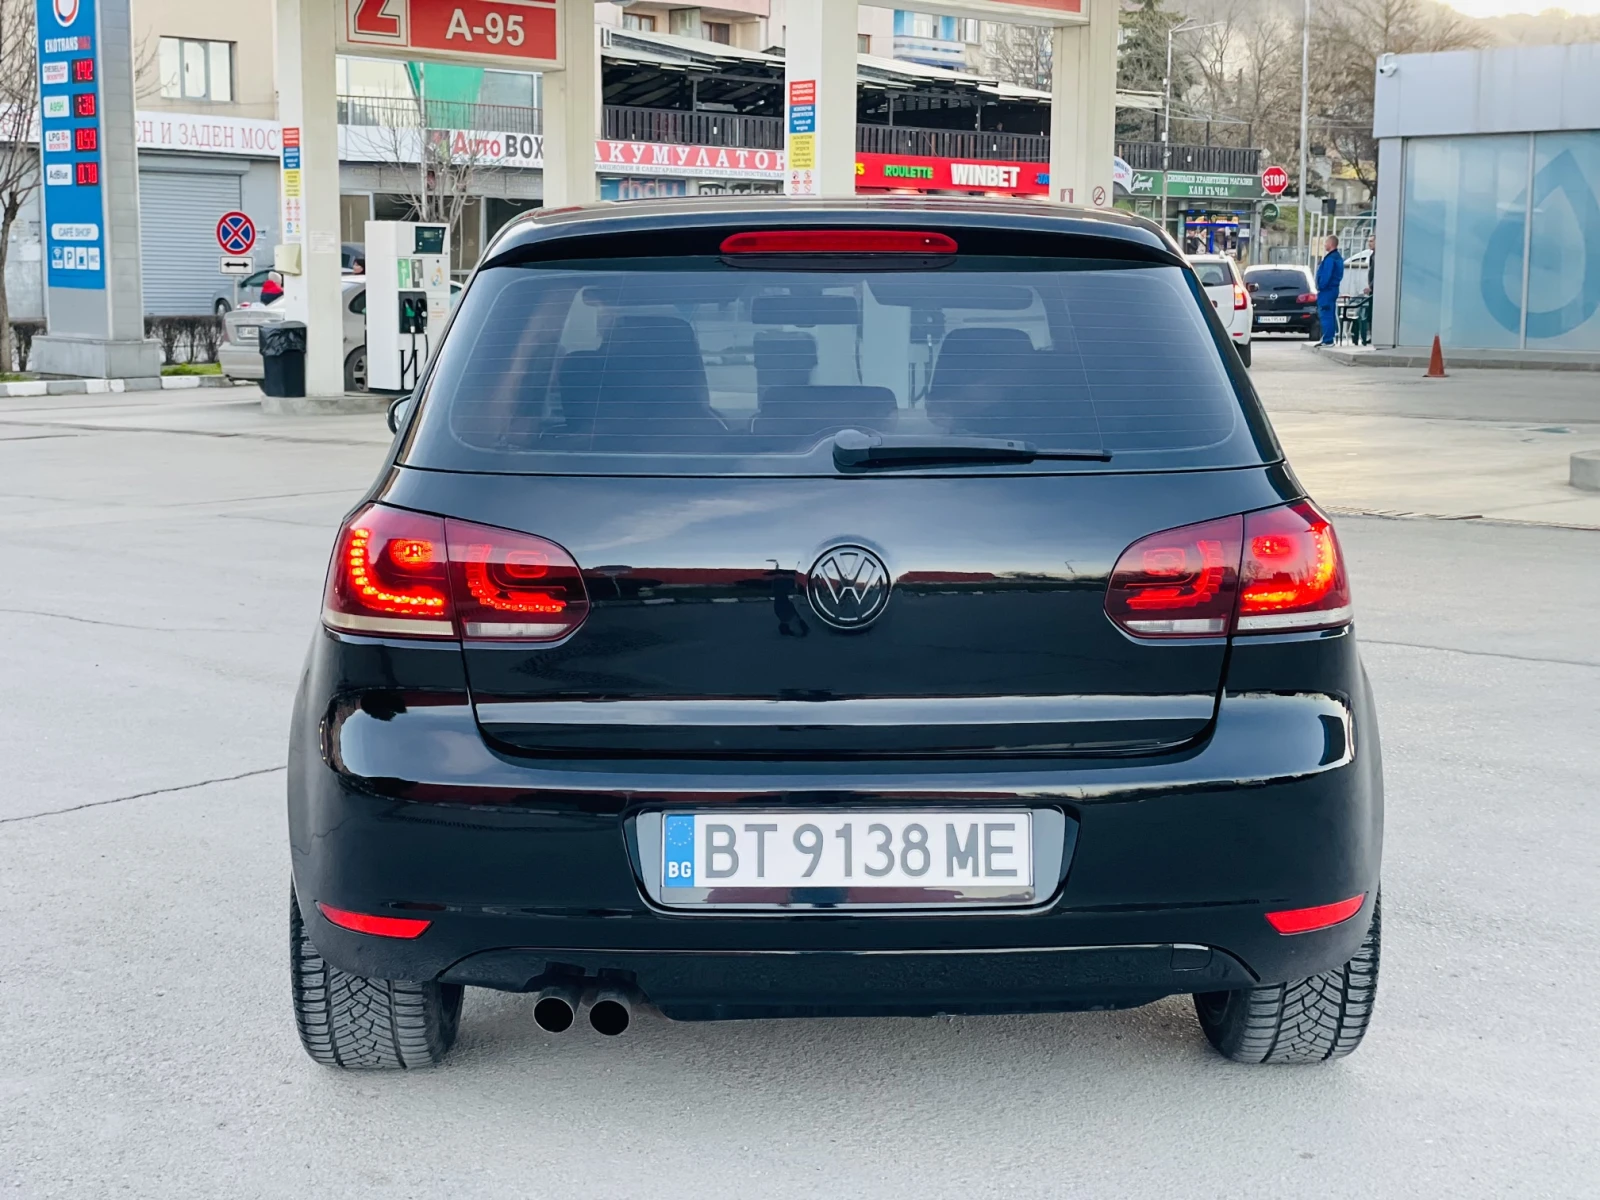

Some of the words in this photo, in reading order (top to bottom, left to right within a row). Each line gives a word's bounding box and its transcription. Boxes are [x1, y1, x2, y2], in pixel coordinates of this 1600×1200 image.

[445, 8, 525, 46] A-95
[48, 132, 60, 141] LPG
[179, 123, 235, 149] ЗАДЕН
[241, 127, 281, 150] МОС
[49, 170, 68, 180] AdBlue
[884, 164, 934, 179] ROULETTE
[950, 163, 1020, 187] WINBET
[1264, 175, 1286, 187] STOP
[1188, 185, 1203, 195] ХАН
[1204, 186, 1228, 196] БЪЧВА
[75, 227, 91, 237] SHOP
[705, 823, 778, 878] BT
[792, 823, 931, 878] 9138
[945, 823, 1018, 878] ME
[668, 861, 692, 878] BG
